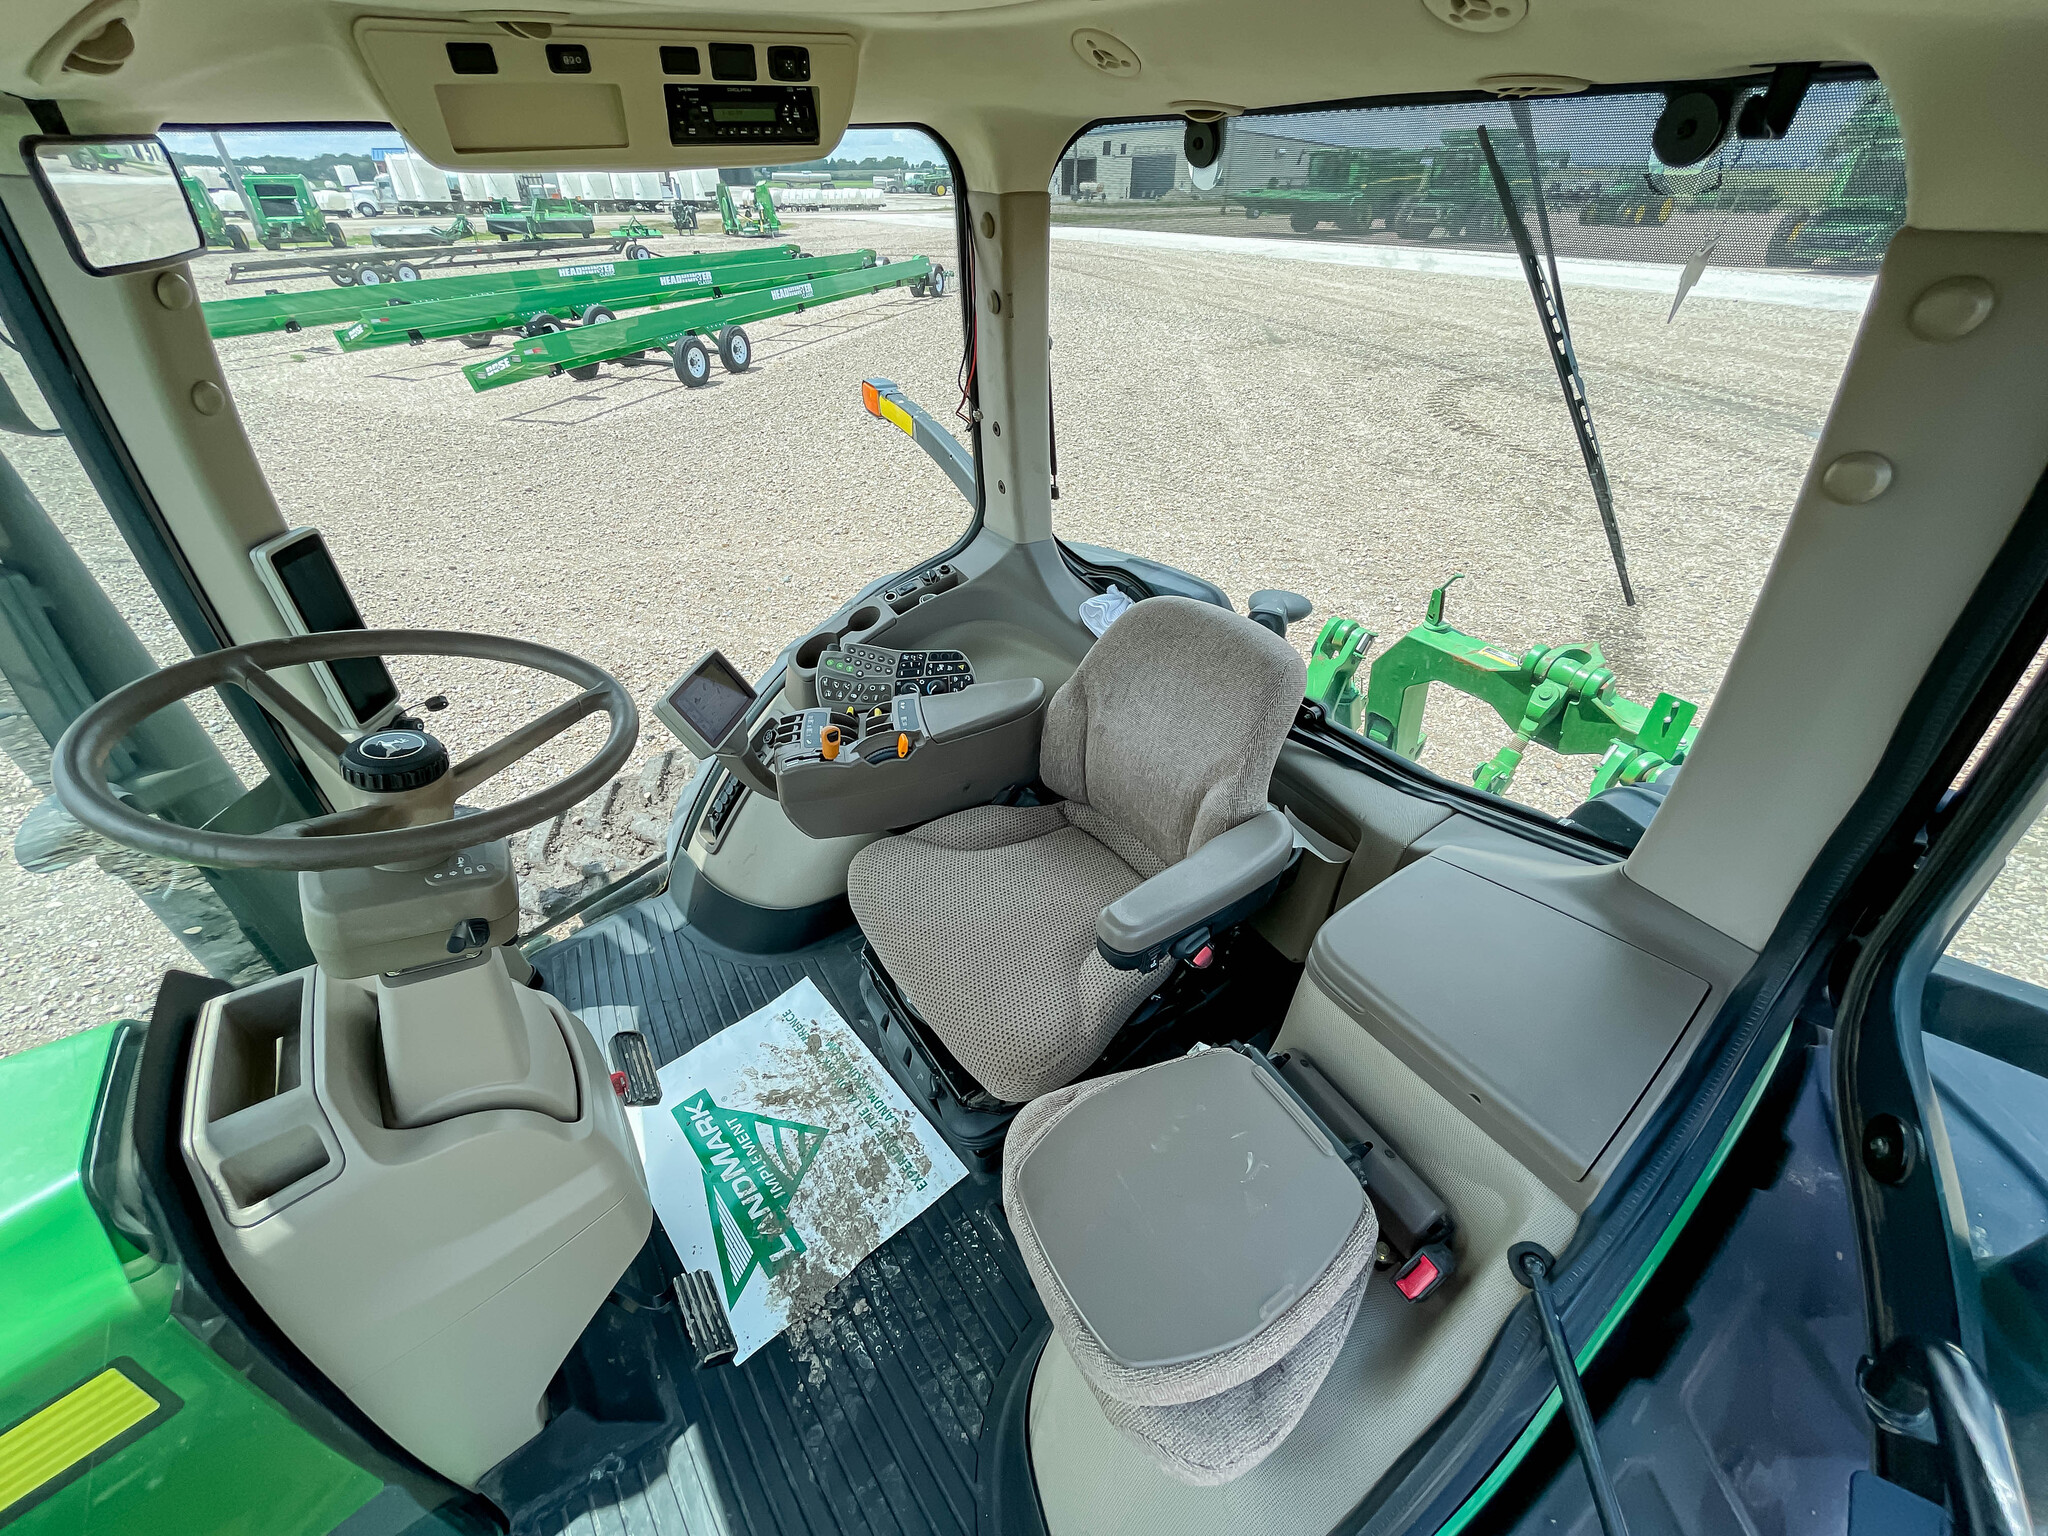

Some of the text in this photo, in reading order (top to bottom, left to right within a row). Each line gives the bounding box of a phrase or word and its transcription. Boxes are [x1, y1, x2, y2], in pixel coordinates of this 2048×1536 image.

[559, 264, 615, 277] HEADHUNTER
[660, 271, 713, 286] HEADHUNTER
[770, 283, 814, 300] HEADHUNTER
[725, 1117, 786, 1199] IMPLEMENT
[684, 1098, 796, 1263] LANDMARK
